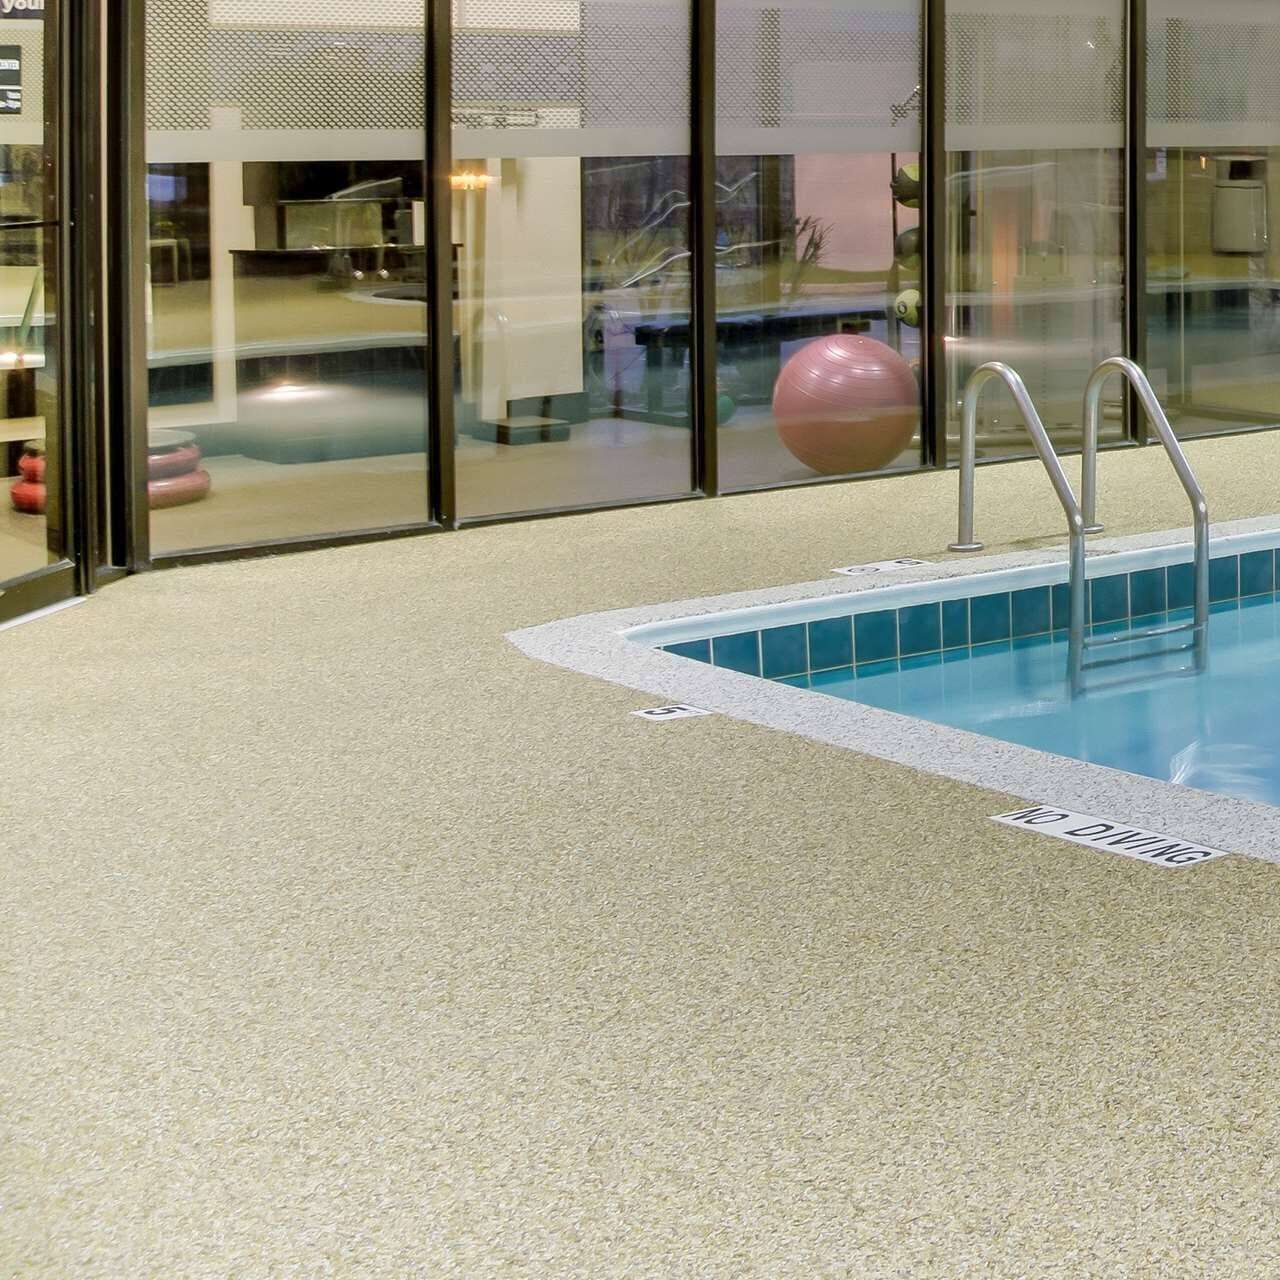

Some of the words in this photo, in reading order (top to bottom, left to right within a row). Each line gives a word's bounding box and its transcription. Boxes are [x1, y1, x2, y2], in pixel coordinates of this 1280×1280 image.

[644, 706, 689, 716] 5
[1002, 807, 1069, 825] NO
[1064, 823, 1212, 864] DIVING
